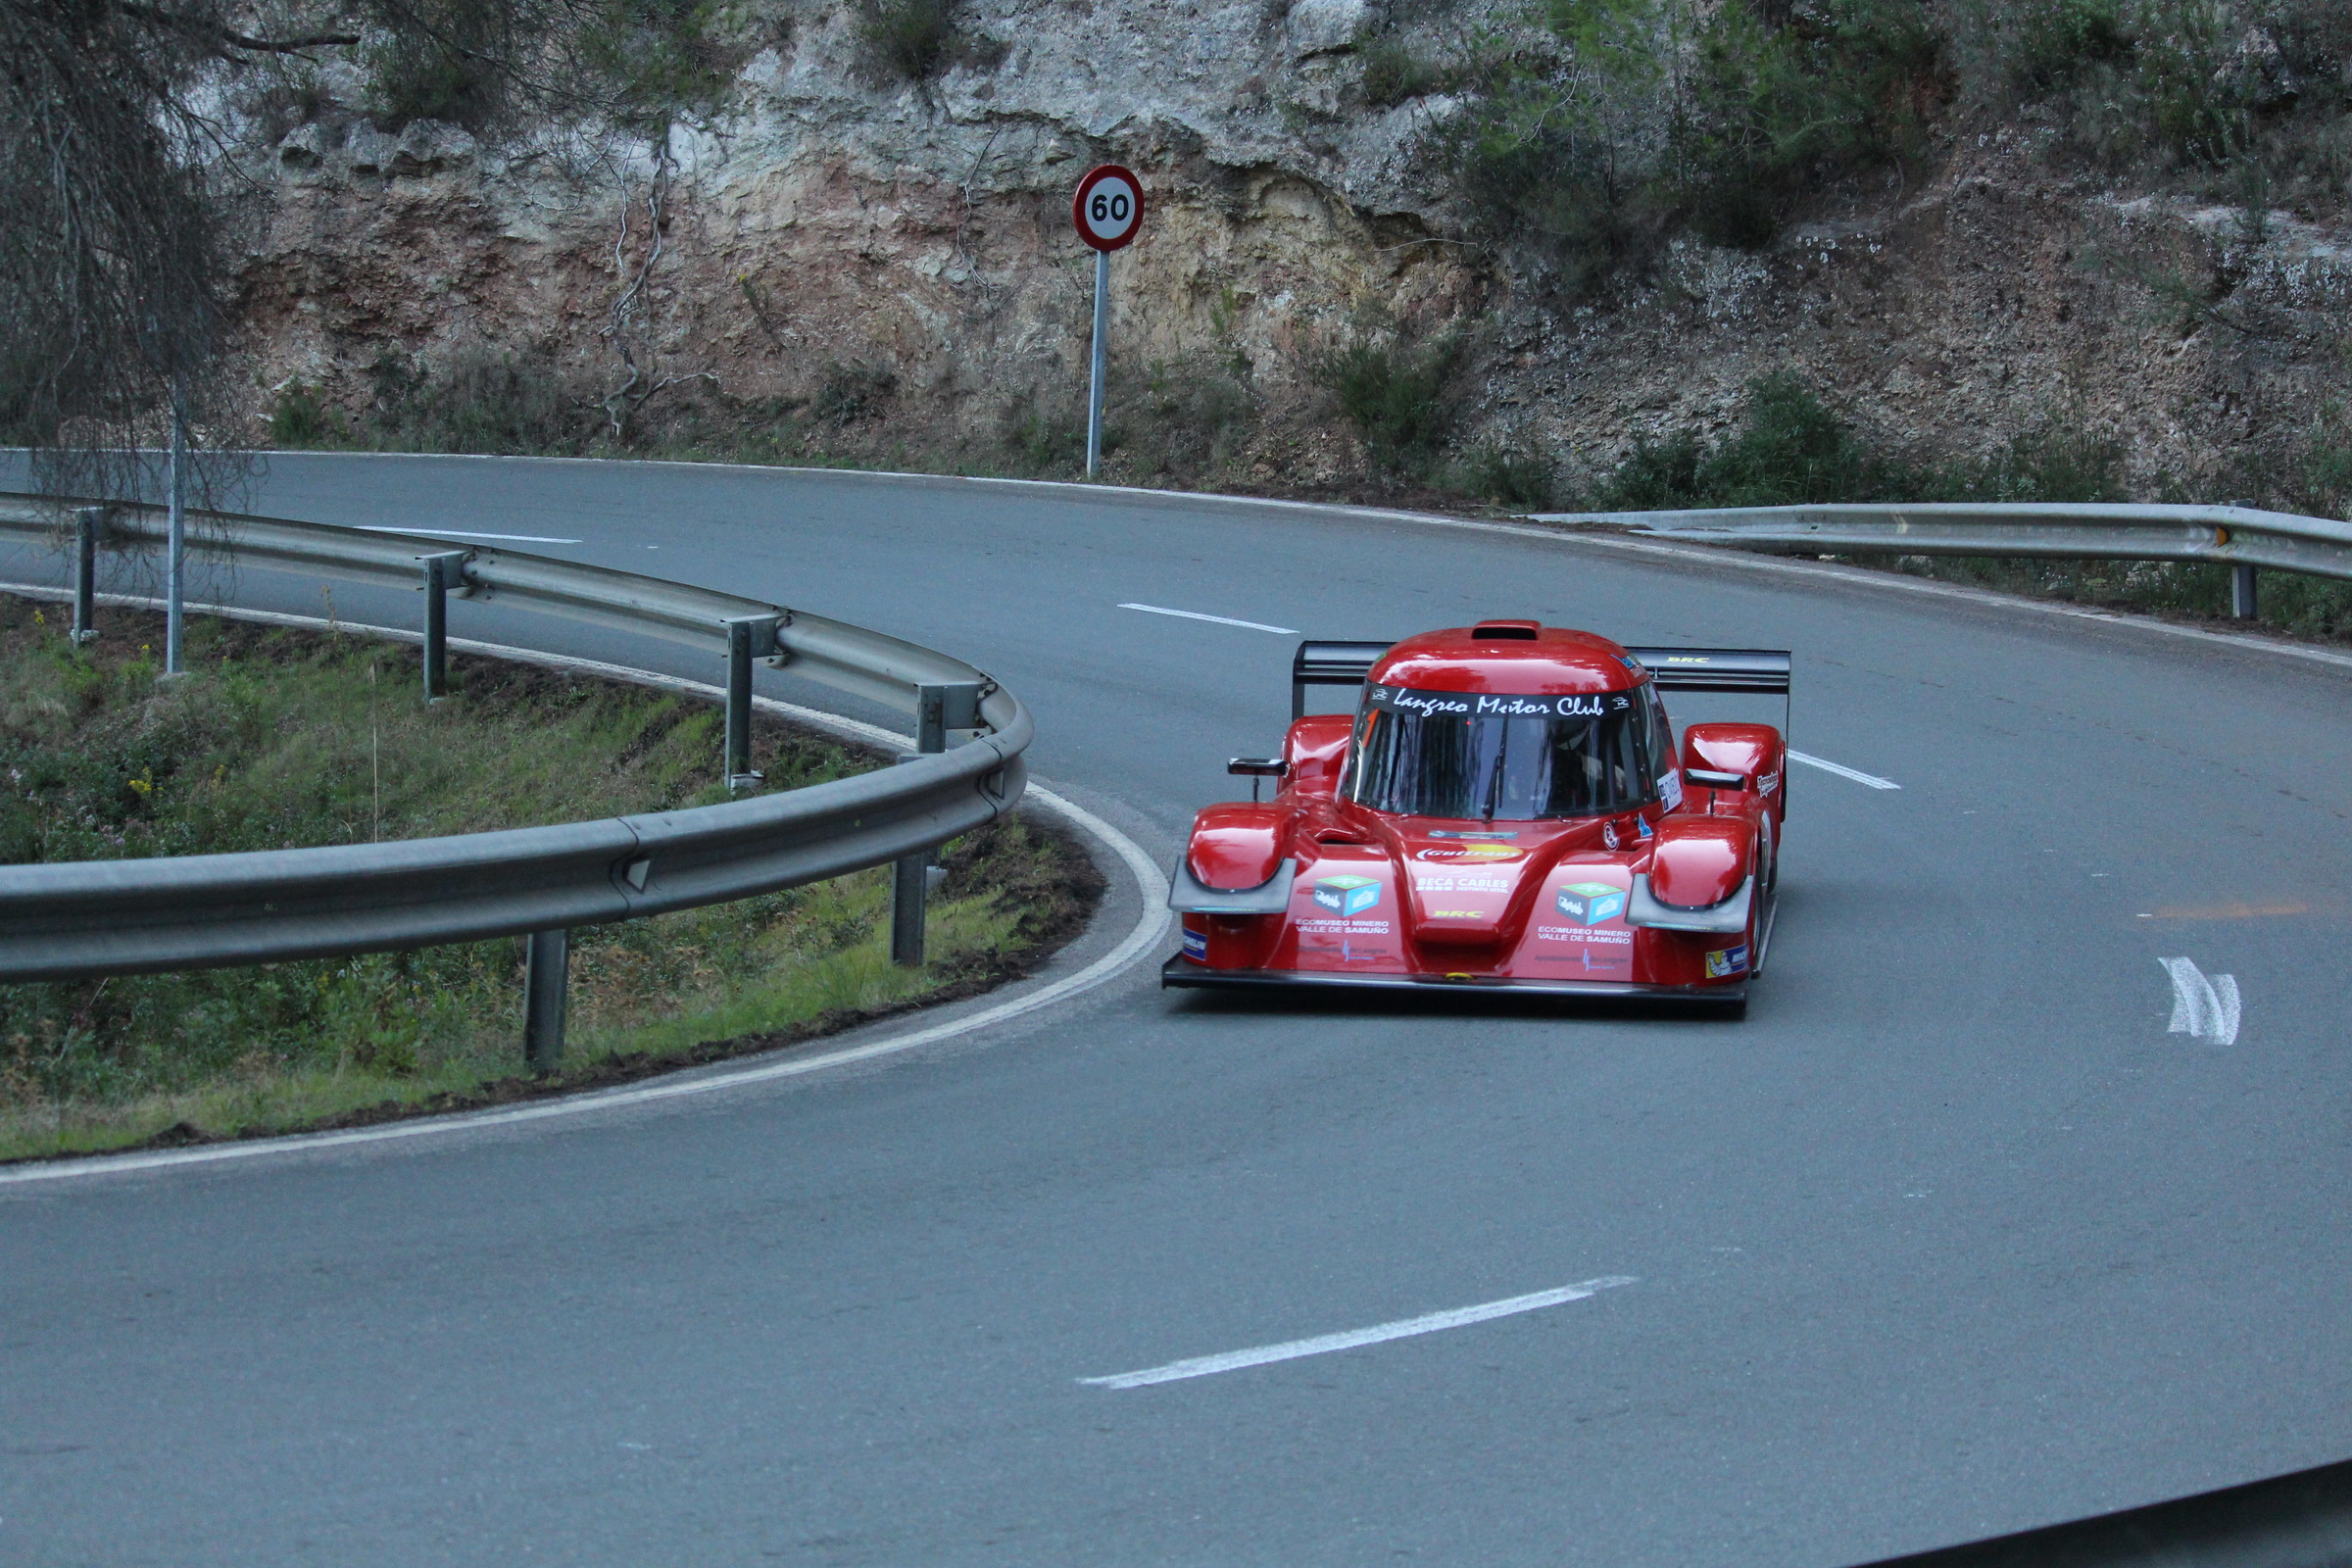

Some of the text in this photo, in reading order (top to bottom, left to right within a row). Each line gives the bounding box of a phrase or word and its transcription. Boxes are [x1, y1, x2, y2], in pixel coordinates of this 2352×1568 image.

[1091, 194, 1129, 221] 60
[1393, 687, 1605, 717] Langreo Motor Club
[1417, 878, 1509, 889] BECA CABLES
[1345, 926, 1390, 935] SAMUÑO
[1538, 926, 1632, 938] ECOMUSEO MINERO
[1586, 936, 1631, 945] SAMUÑO
